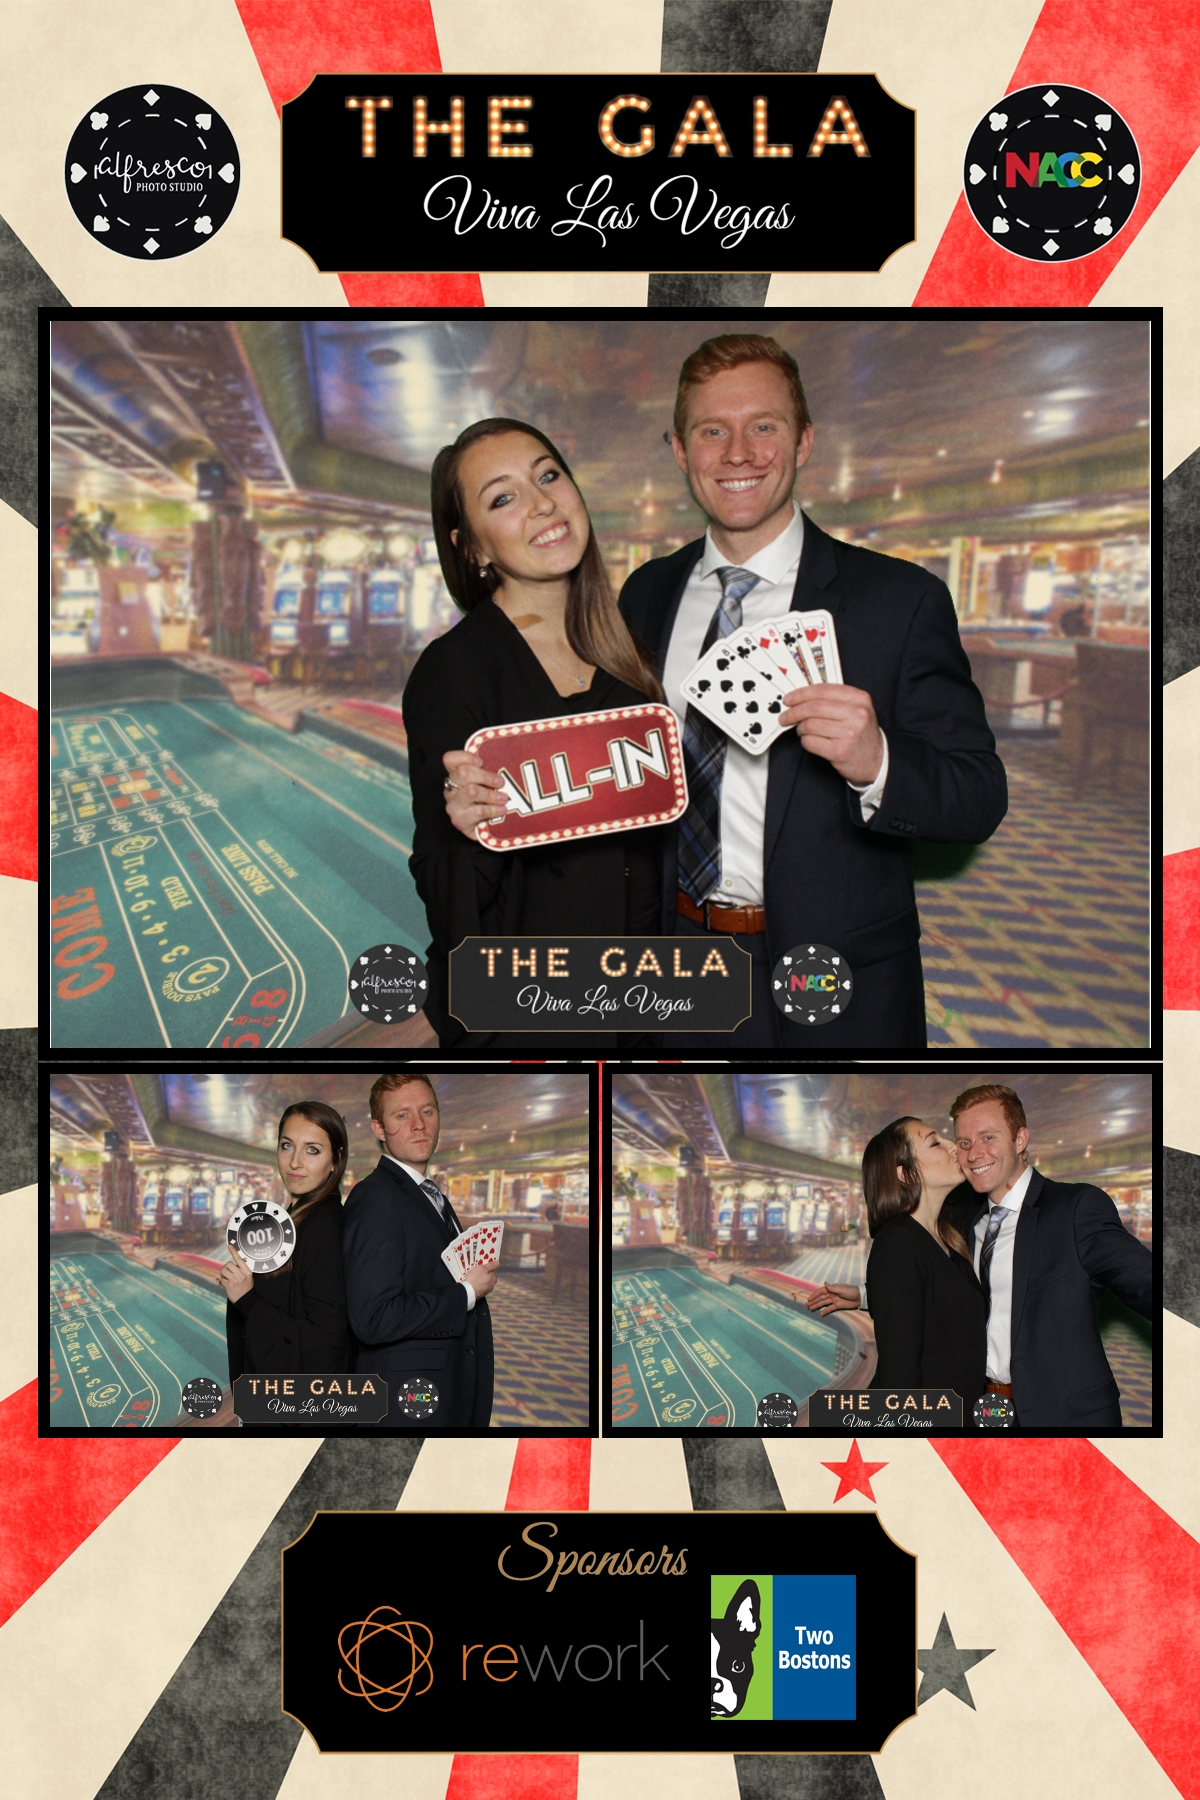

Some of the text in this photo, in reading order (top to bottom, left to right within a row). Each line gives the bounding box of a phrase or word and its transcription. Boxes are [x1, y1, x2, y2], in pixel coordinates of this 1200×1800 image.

[488, 727, 671, 824] ALL-IN
[221, 843, 275, 896] PASS LINE
[122, 854, 190, 964] 3 4 9 10 11
[160, 876, 193, 910] FIELD
[51, 886, 116, 1000] COME
[188, 963, 219, 985] 2
[250, 988, 287, 1009] 8
[247, 1227, 274, 1246] 100
[131, 1400, 150, 1411] 8
